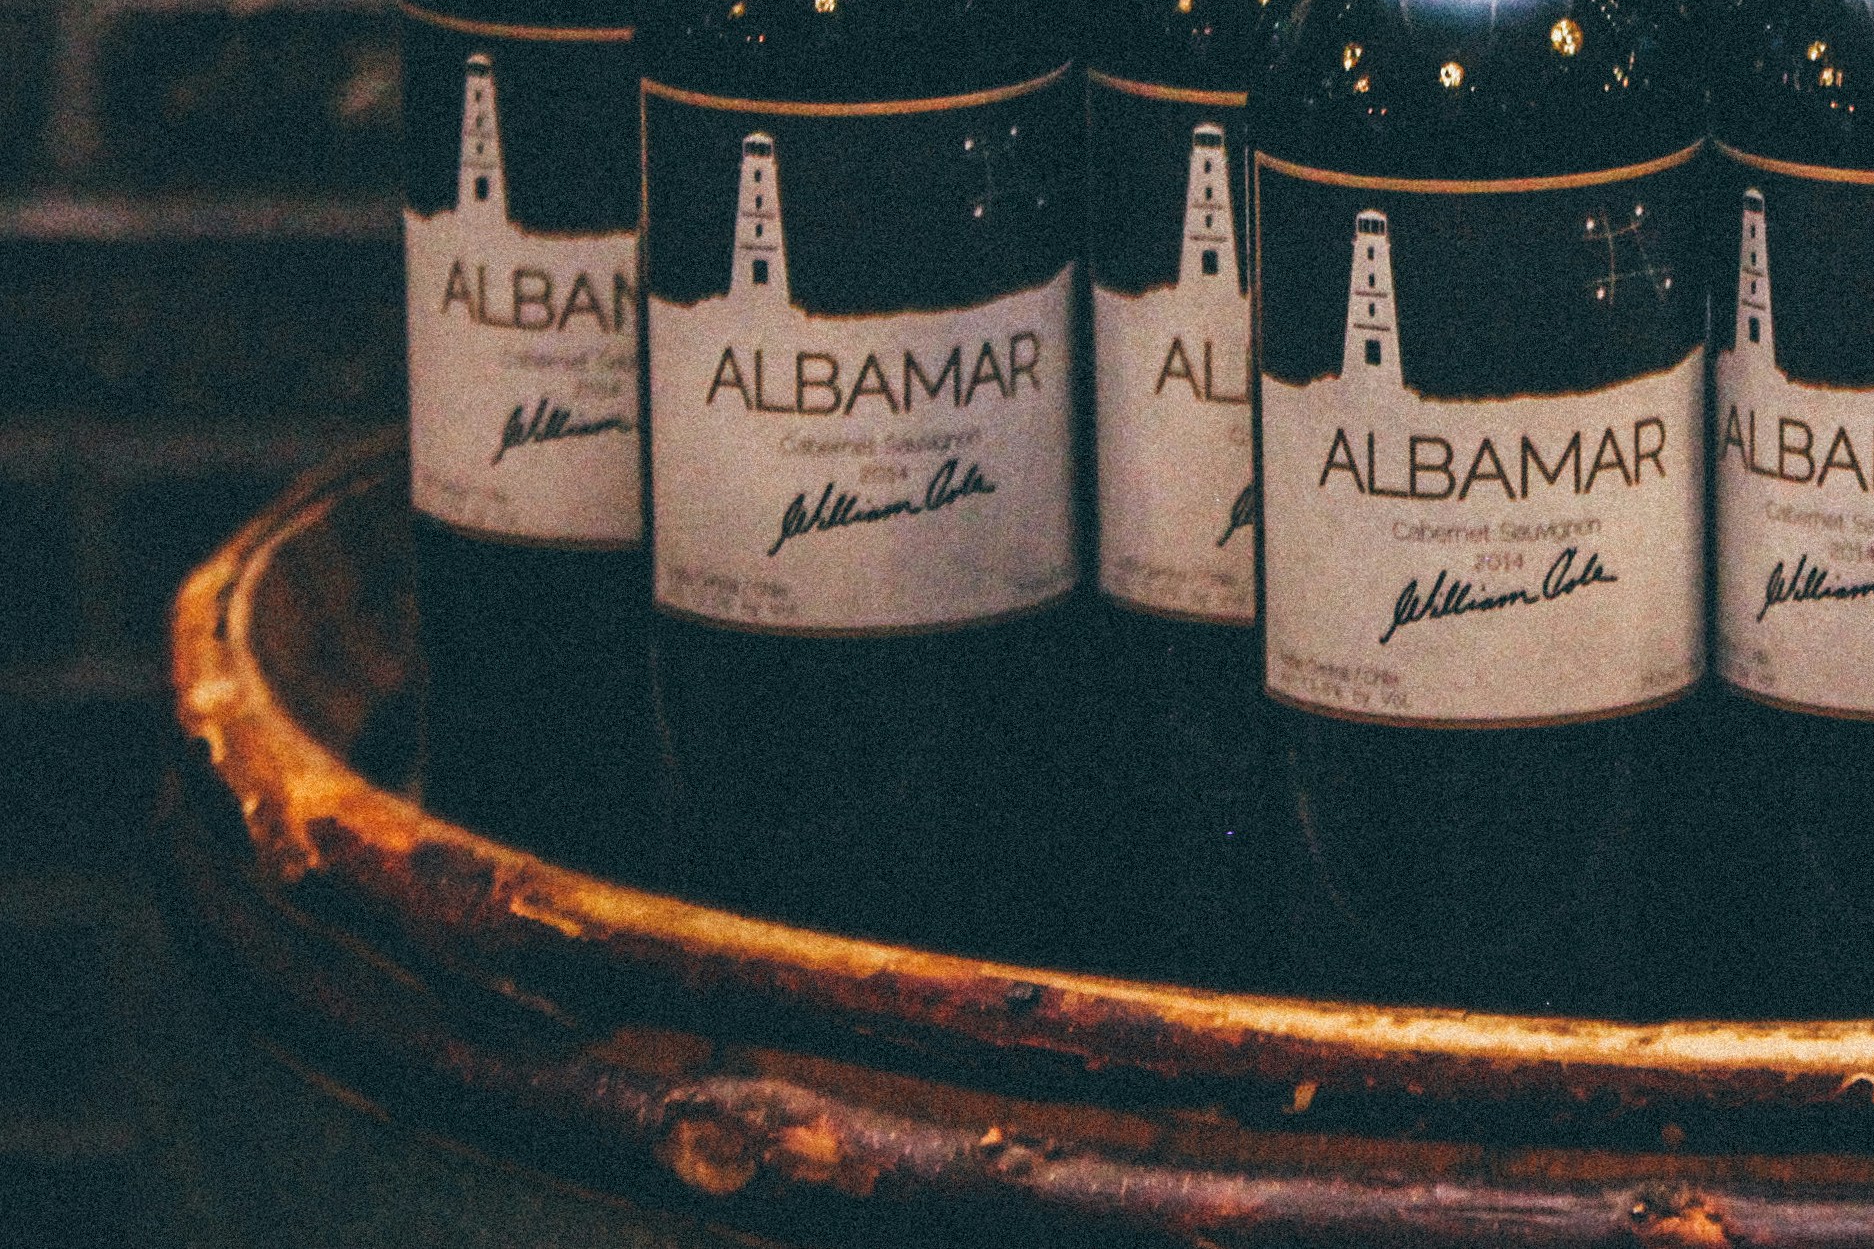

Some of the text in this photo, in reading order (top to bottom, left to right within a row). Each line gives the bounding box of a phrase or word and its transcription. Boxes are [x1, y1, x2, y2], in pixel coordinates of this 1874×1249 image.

[706, 332, 1041, 416] ALBAMAR
[1154, 336, 1252, 405] AL
[1318, 416, 1668, 502] ALBAMAR
[1391, 517, 1602, 544] Cabernet Sauvignon
[1472, 552, 1525, 572] 2014
